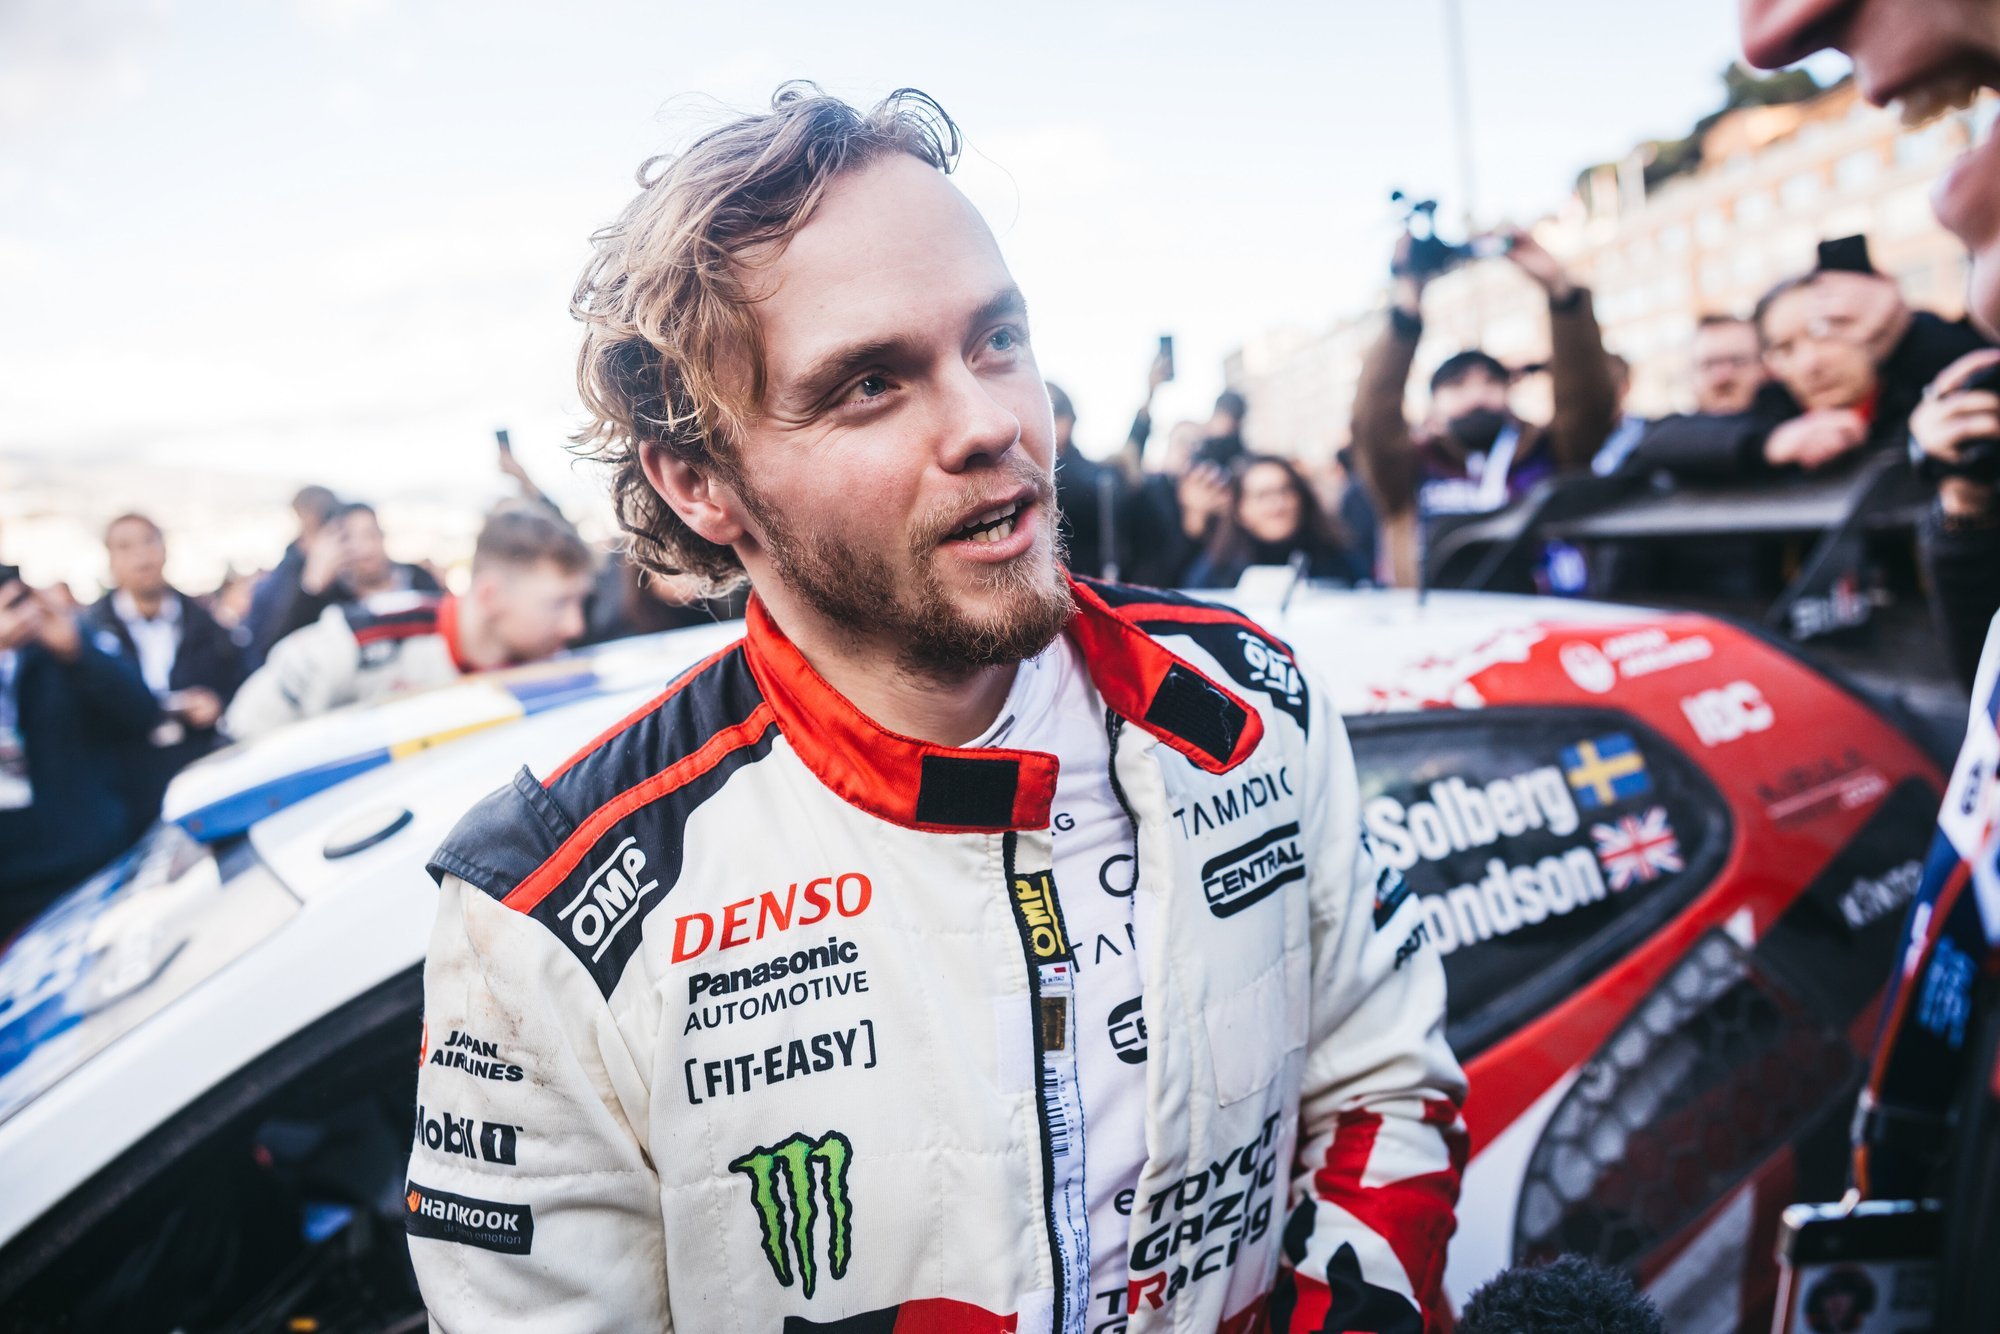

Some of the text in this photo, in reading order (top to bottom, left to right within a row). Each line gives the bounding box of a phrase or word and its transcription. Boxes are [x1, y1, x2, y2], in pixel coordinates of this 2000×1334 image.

[1365, 764, 1580, 871] Solberg
[571, 847, 647, 946] OMP
[1203, 841, 1304, 904] CENTRAL
[1419, 845, 1607, 956] ondson
[671, 872, 873, 965] DENSO
[1015, 879, 1057, 957] OMP
[683, 970, 870, 1036] AUTOMOTIVE
[688, 936, 859, 1005] Panasonic
[430, 1049, 524, 1082] AIRLINES
[444, 1030, 498, 1059] JAPAN
[1148, 1109, 1281, 1224] TOYOT
[474, 1230, 522, 1245] emotion
